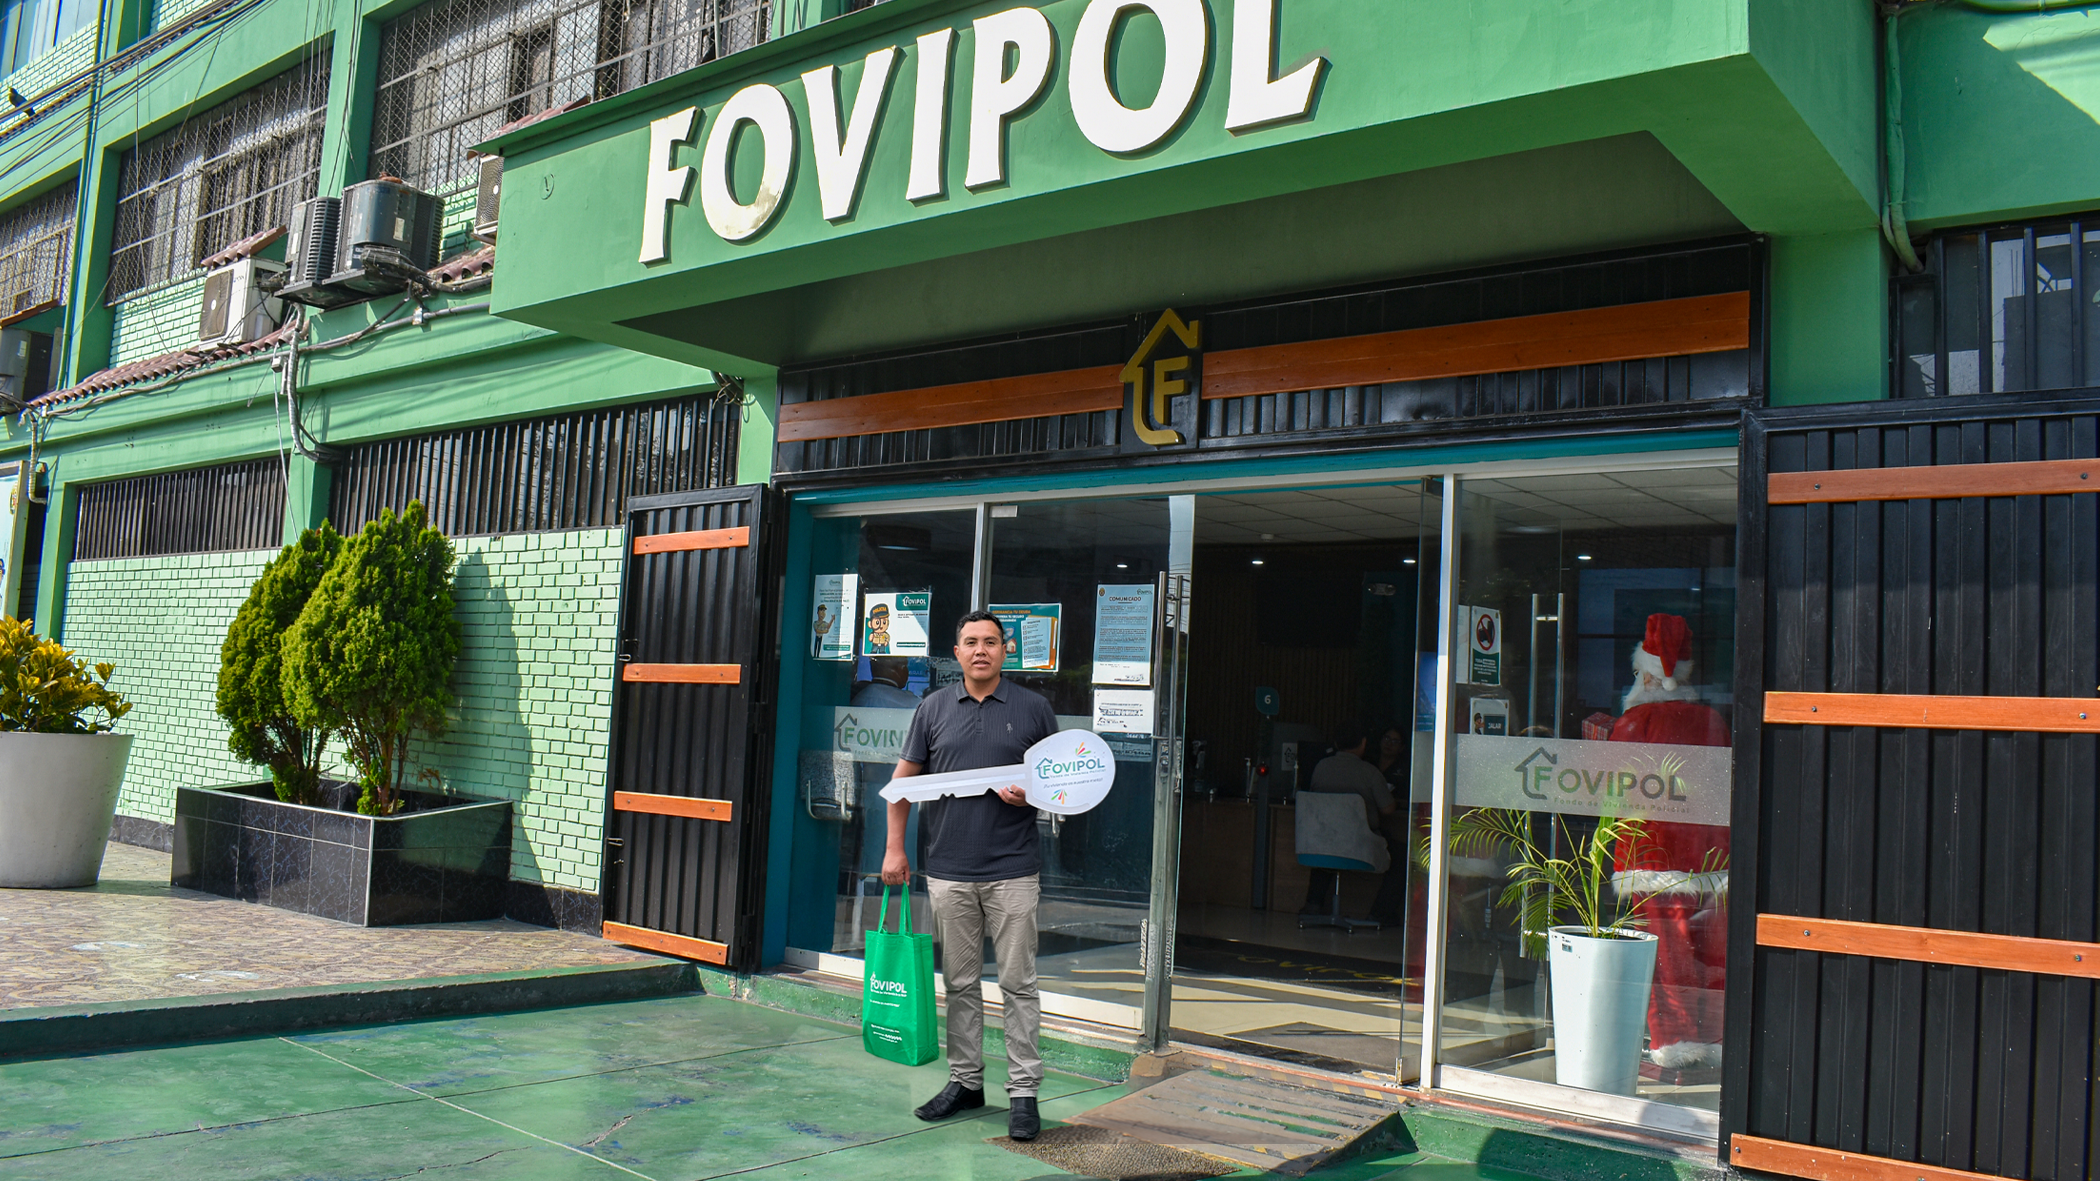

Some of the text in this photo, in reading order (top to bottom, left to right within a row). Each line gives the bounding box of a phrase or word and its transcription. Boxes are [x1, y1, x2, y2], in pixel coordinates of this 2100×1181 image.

[639, 0, 1326, 266] FOVIPOL
[1264, 694, 1271, 704] 6
[1043, 758, 1105, 775] FOVIPOL
[1533, 765, 1688, 802] FOVIPOL
[1554, 797, 1583, 807] Fondo
[1603, 800, 1646, 811] Vivienda
[1650, 803, 1690, 813] Policial
[871, 979, 907, 993] FOVIPOL
